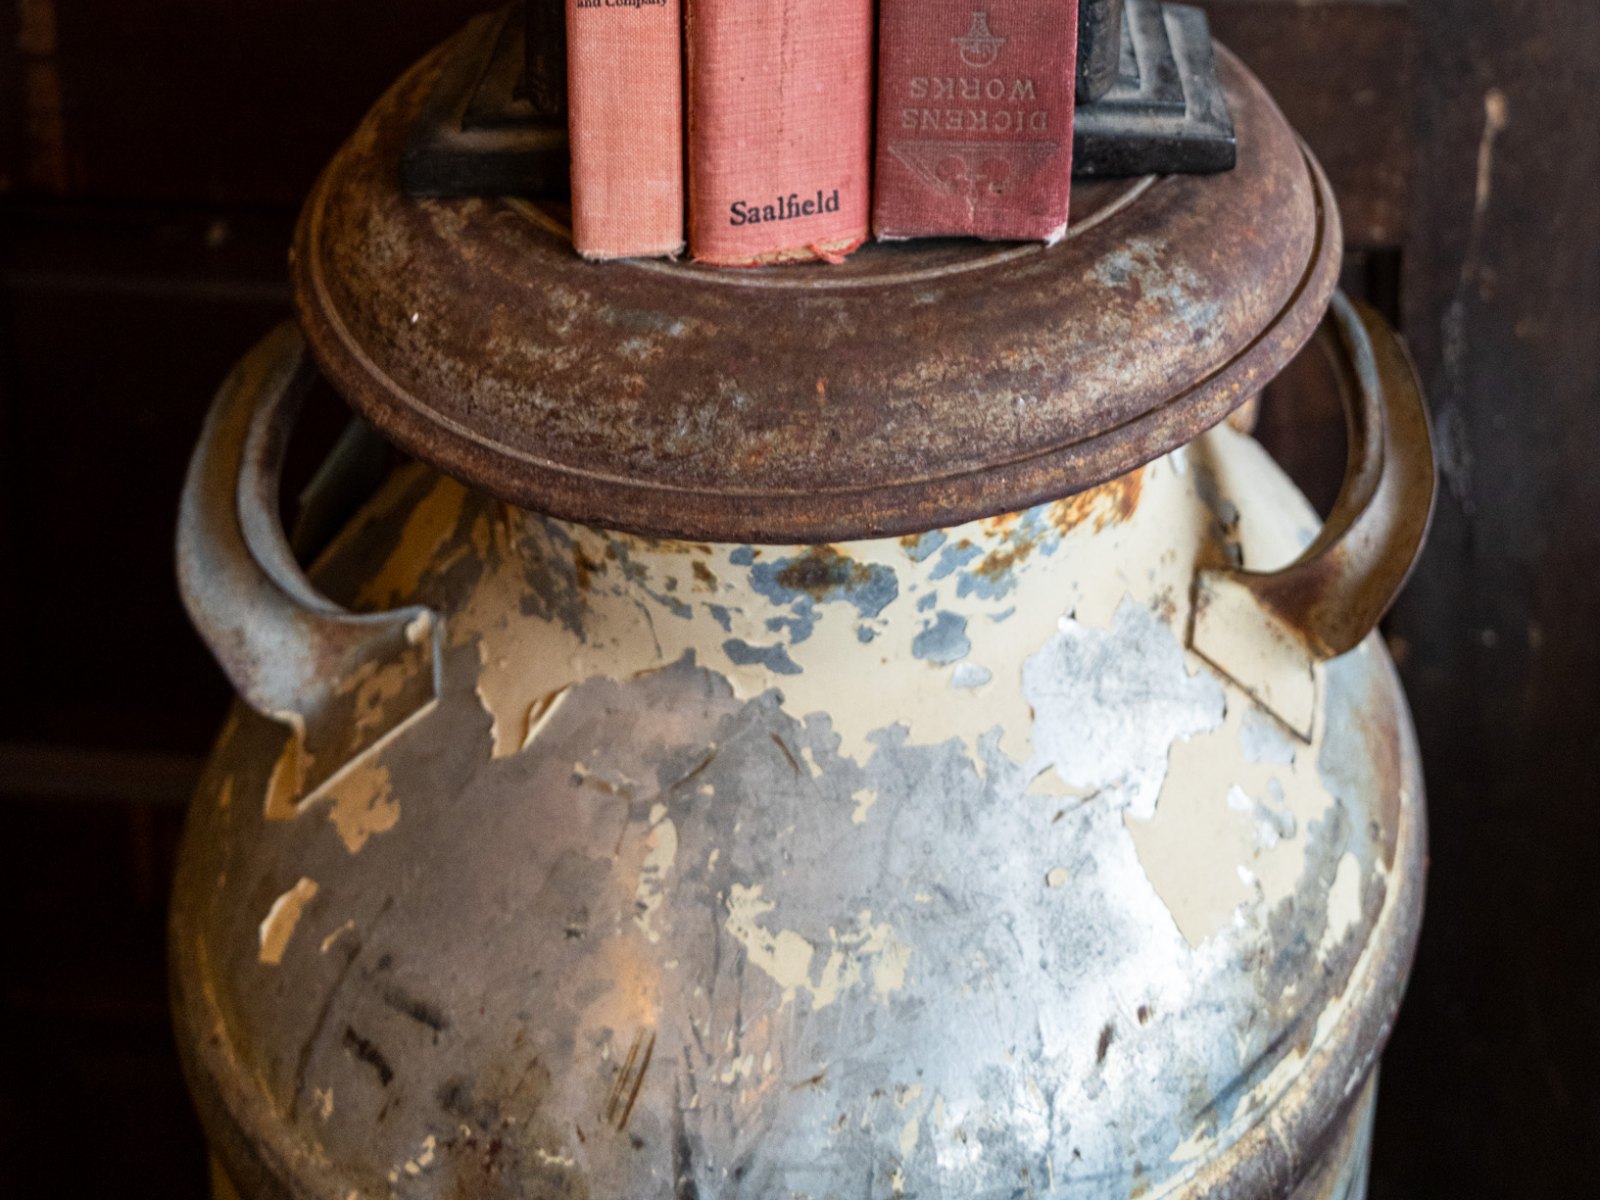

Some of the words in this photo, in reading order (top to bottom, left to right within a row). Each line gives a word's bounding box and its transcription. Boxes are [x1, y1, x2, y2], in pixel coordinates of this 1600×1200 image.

[910, 77, 1037, 101] WORKS
[901, 108, 1049, 133] DICKENS
[729, 190, 840, 226] Saalfield
